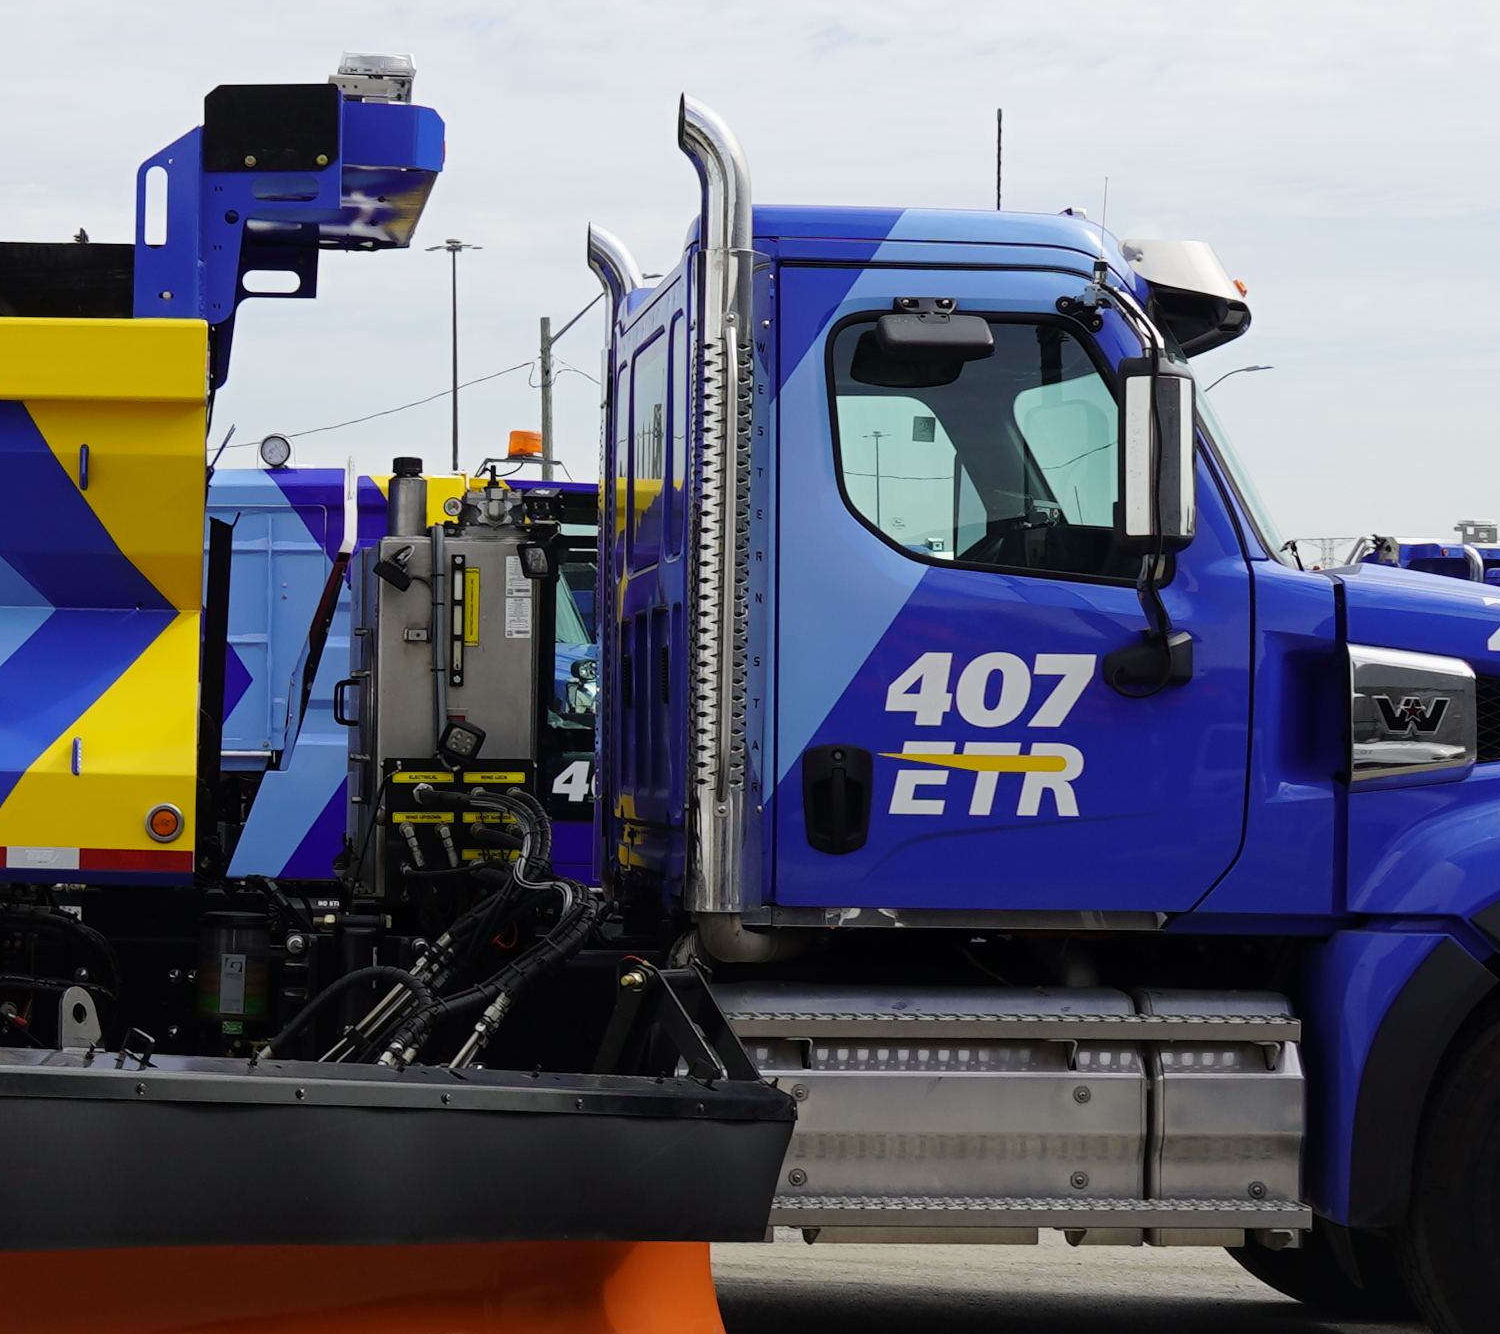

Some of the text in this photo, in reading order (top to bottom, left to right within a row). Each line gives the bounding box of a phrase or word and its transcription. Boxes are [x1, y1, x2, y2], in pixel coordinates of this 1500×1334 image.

[884, 651, 1098, 728] 407
[552, 761, 596, 802] 4
[888, 740, 1084, 817] ETR
